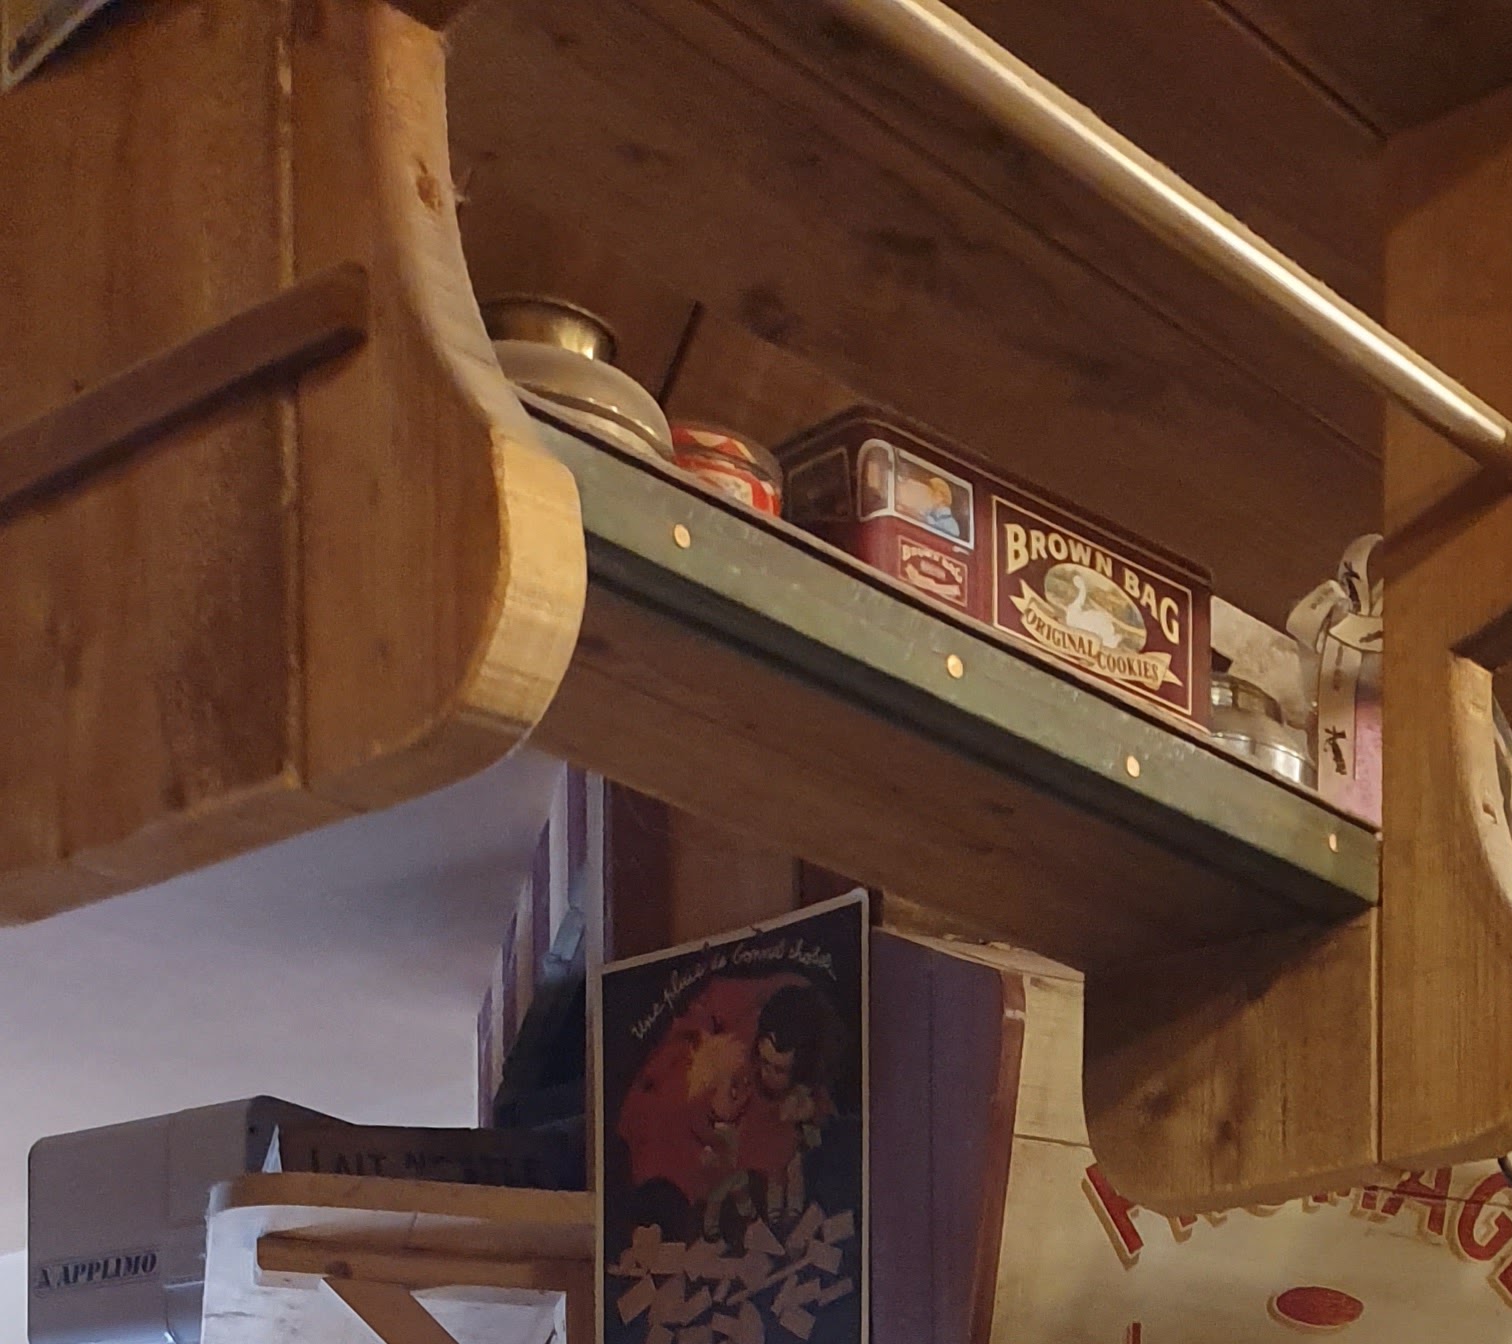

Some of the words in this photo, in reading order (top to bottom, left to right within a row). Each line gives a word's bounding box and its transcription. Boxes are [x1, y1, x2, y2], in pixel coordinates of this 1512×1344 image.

[1003, 522, 1114, 578] BROWN
[1123, 568, 1180, 645] BAG
[1025, 603, 1097, 657] ORIGINAL
[1097, 652, 1160, 681] COOKIES
[62, 1252, 158, 1285] APPLIMO
